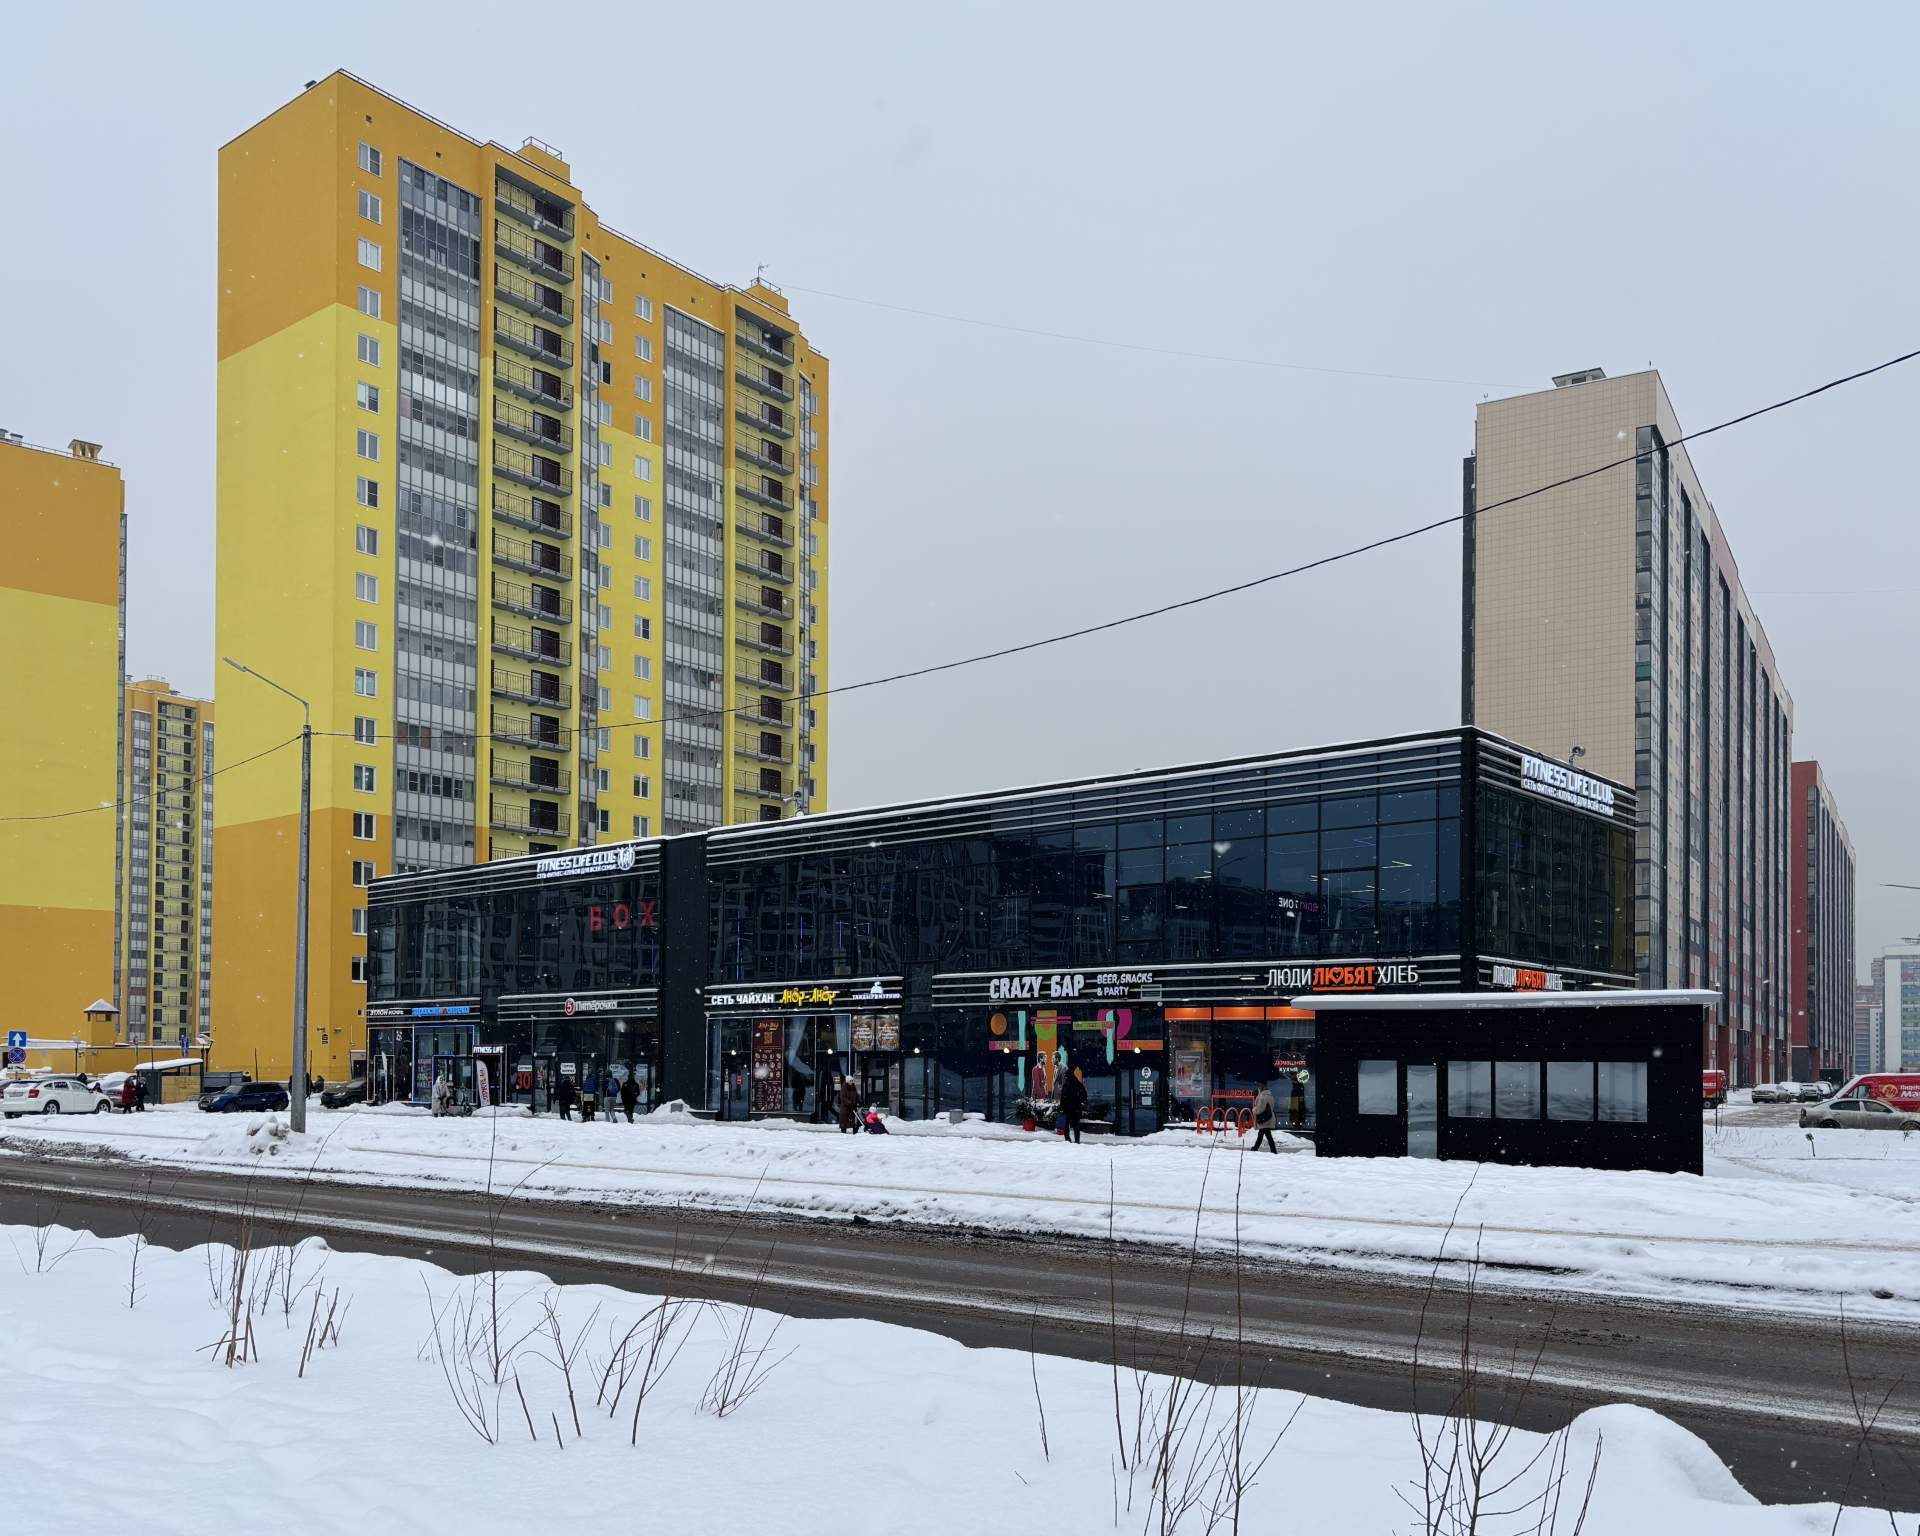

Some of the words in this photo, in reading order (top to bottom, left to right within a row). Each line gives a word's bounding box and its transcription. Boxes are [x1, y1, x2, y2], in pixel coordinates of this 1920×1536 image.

[1524, 757, 1567, 789] FITNESS
[1568, 770, 1589, 796] LIFE
[1591, 779, 1615, 805] CLUB
[536, 856, 572, 872] FITNESS
[572, 853, 592, 868] LIFE
[592, 850, 617, 865] CLUB
[990, 976, 1042, 999] CRAZY
[1050, 974, 1085, 997] БАР
[1120, 972, 1153, 983] SNACKS
[1268, 969, 1311, 988] ЛЮДИ
[1313, 966, 1376, 985] ЛЮБЯТ
[1377, 965, 1418, 984] ХЛЕБ
[711, 995, 734, 1006] СЕТЬ
[736, 992, 774, 1004] ЧАЙХАН
[1104, 986, 1129, 996] PARTY
